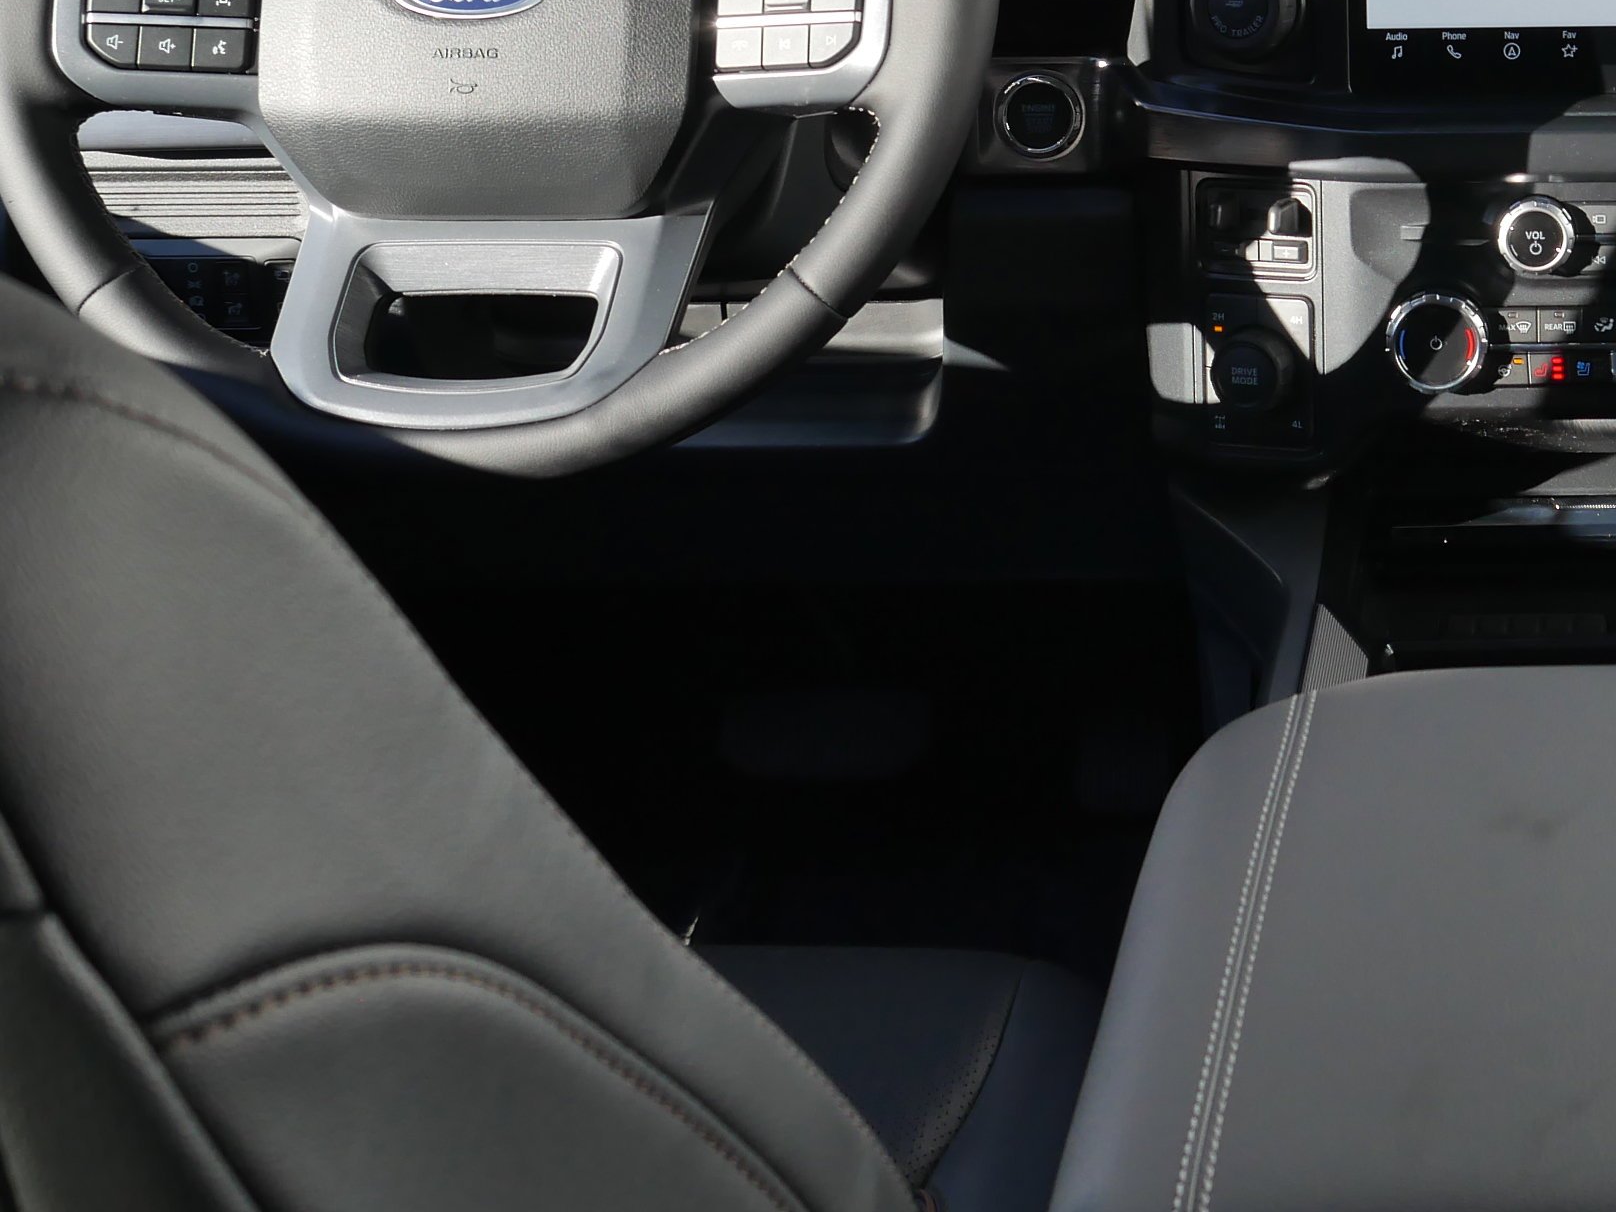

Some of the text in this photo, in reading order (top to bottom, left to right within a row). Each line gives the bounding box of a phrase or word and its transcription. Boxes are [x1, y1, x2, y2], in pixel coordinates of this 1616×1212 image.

[1210, 14, 1264, 37] PRO TRAILER
[1385, 31, 1408, 41] Audio
[1441, 31, 1467, 40] Phone
[1504, 31, 1520, 40] Nav
[1562, 30, 1577, 39] Fav
[432, 47, 499, 59] AIRBAG
[1525, 230, 1546, 240] VOL
[1211, 312, 1225, 321] 2H
[1289, 315, 1303, 325] 4H
[1499, 323, 1516, 331] MAX
[1544, 323, 1563, 331] REAR
[1231, 367, 1258, 376] DRIVE
[1231, 376, 1259, 386] MODE
